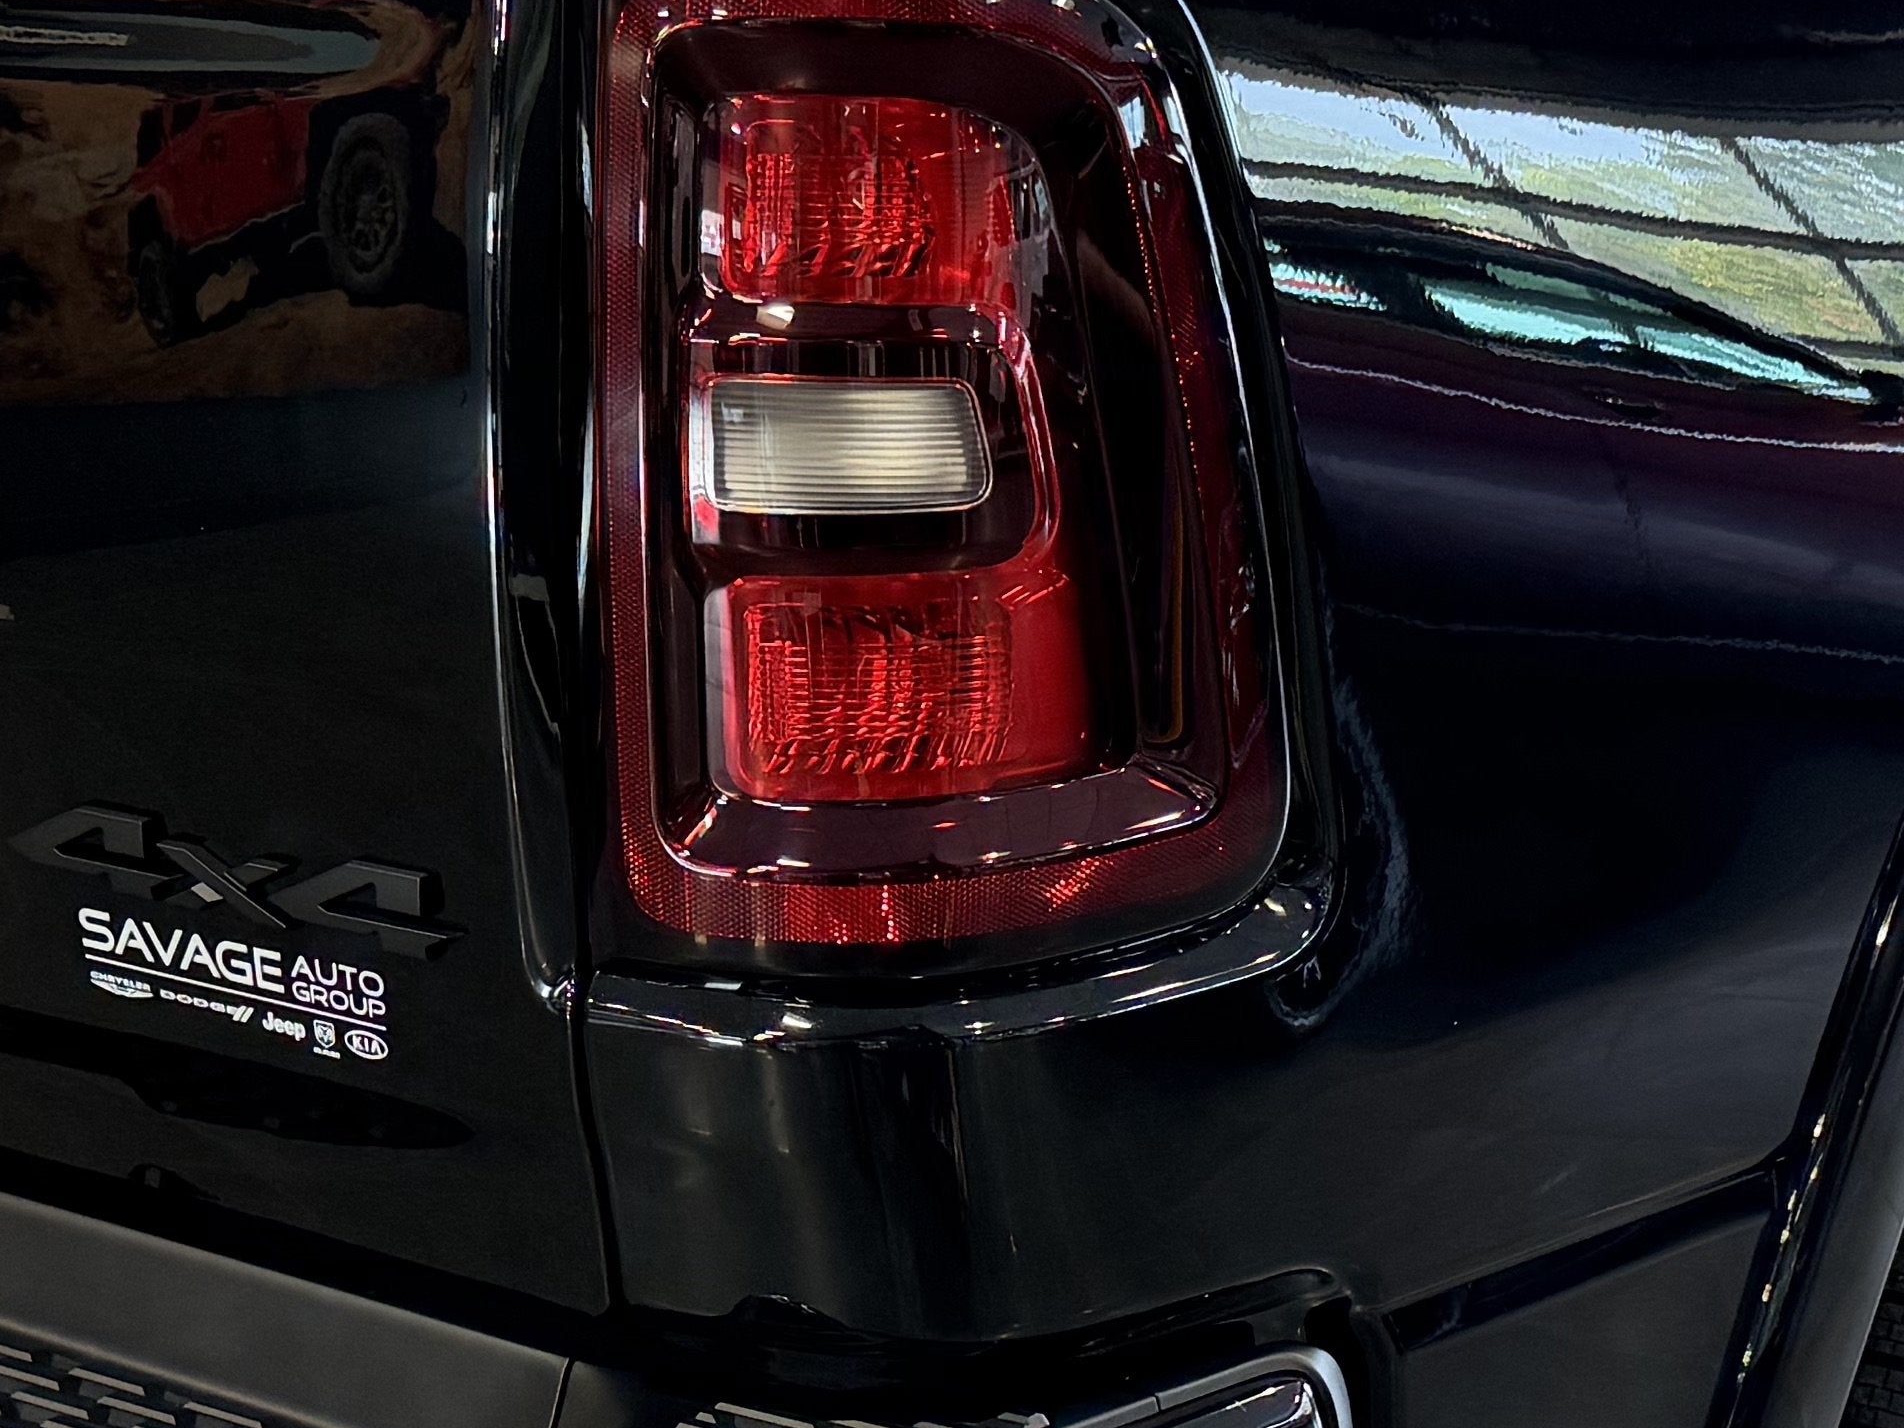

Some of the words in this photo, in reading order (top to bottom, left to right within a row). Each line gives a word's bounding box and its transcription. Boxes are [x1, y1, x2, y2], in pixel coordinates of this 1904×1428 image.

[78, 907, 285, 993] SAVAGE
[291, 955, 384, 998] AUTO
[90, 970, 151, 993] CHRYSLER
[160, 989, 239, 1017] DODGE
[262, 1011, 306, 1042] Jeep
[291, 981, 386, 1019] GROUP
